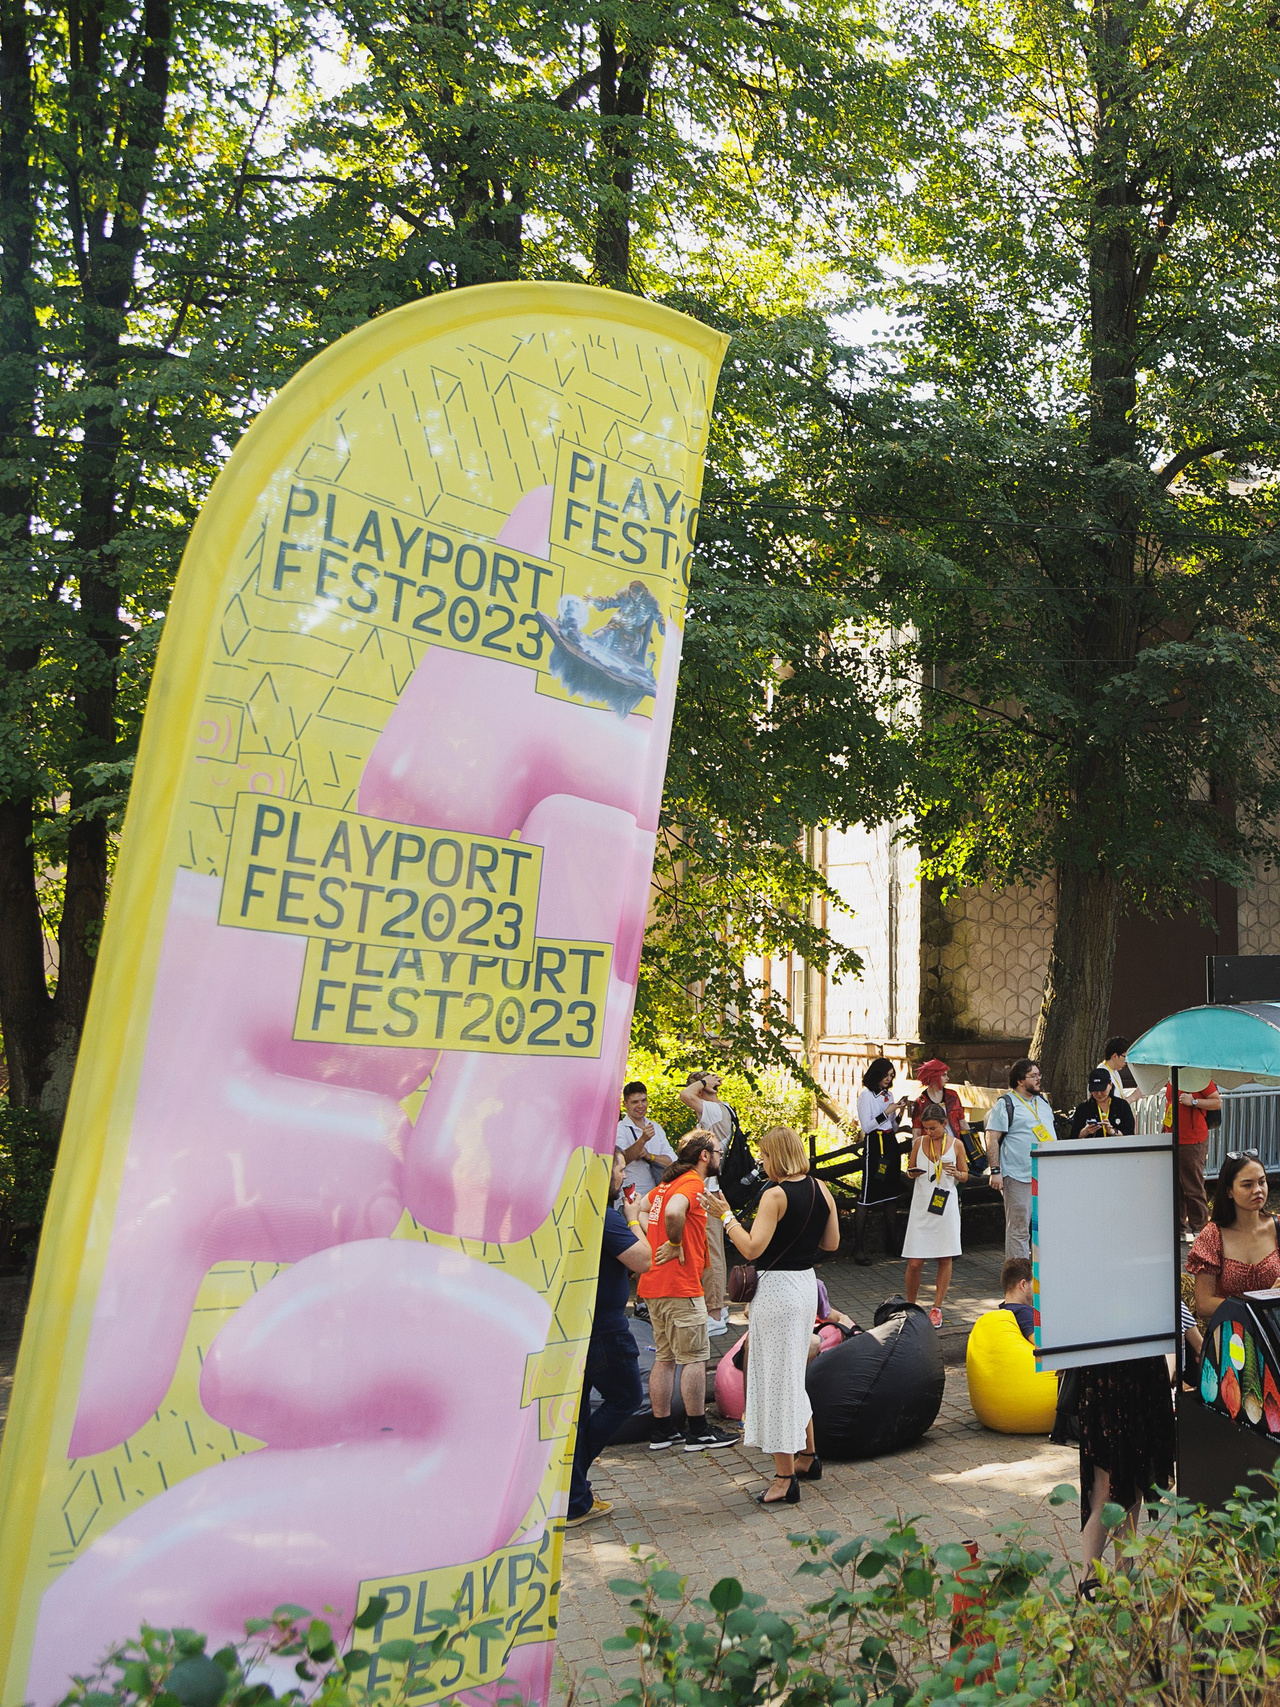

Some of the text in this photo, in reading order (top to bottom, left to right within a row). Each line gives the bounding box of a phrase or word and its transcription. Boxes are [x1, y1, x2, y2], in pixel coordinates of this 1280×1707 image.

[283, 484, 554, 609] PLAYPORT
[274, 541, 544, 661] FEST2023
[251, 804, 532, 896] PLAYPORT
[240, 864, 524, 951] FEST2023
[320, 939, 604, 996] PLAYPORT
[312, 979, 596, 1048] FEST2023
